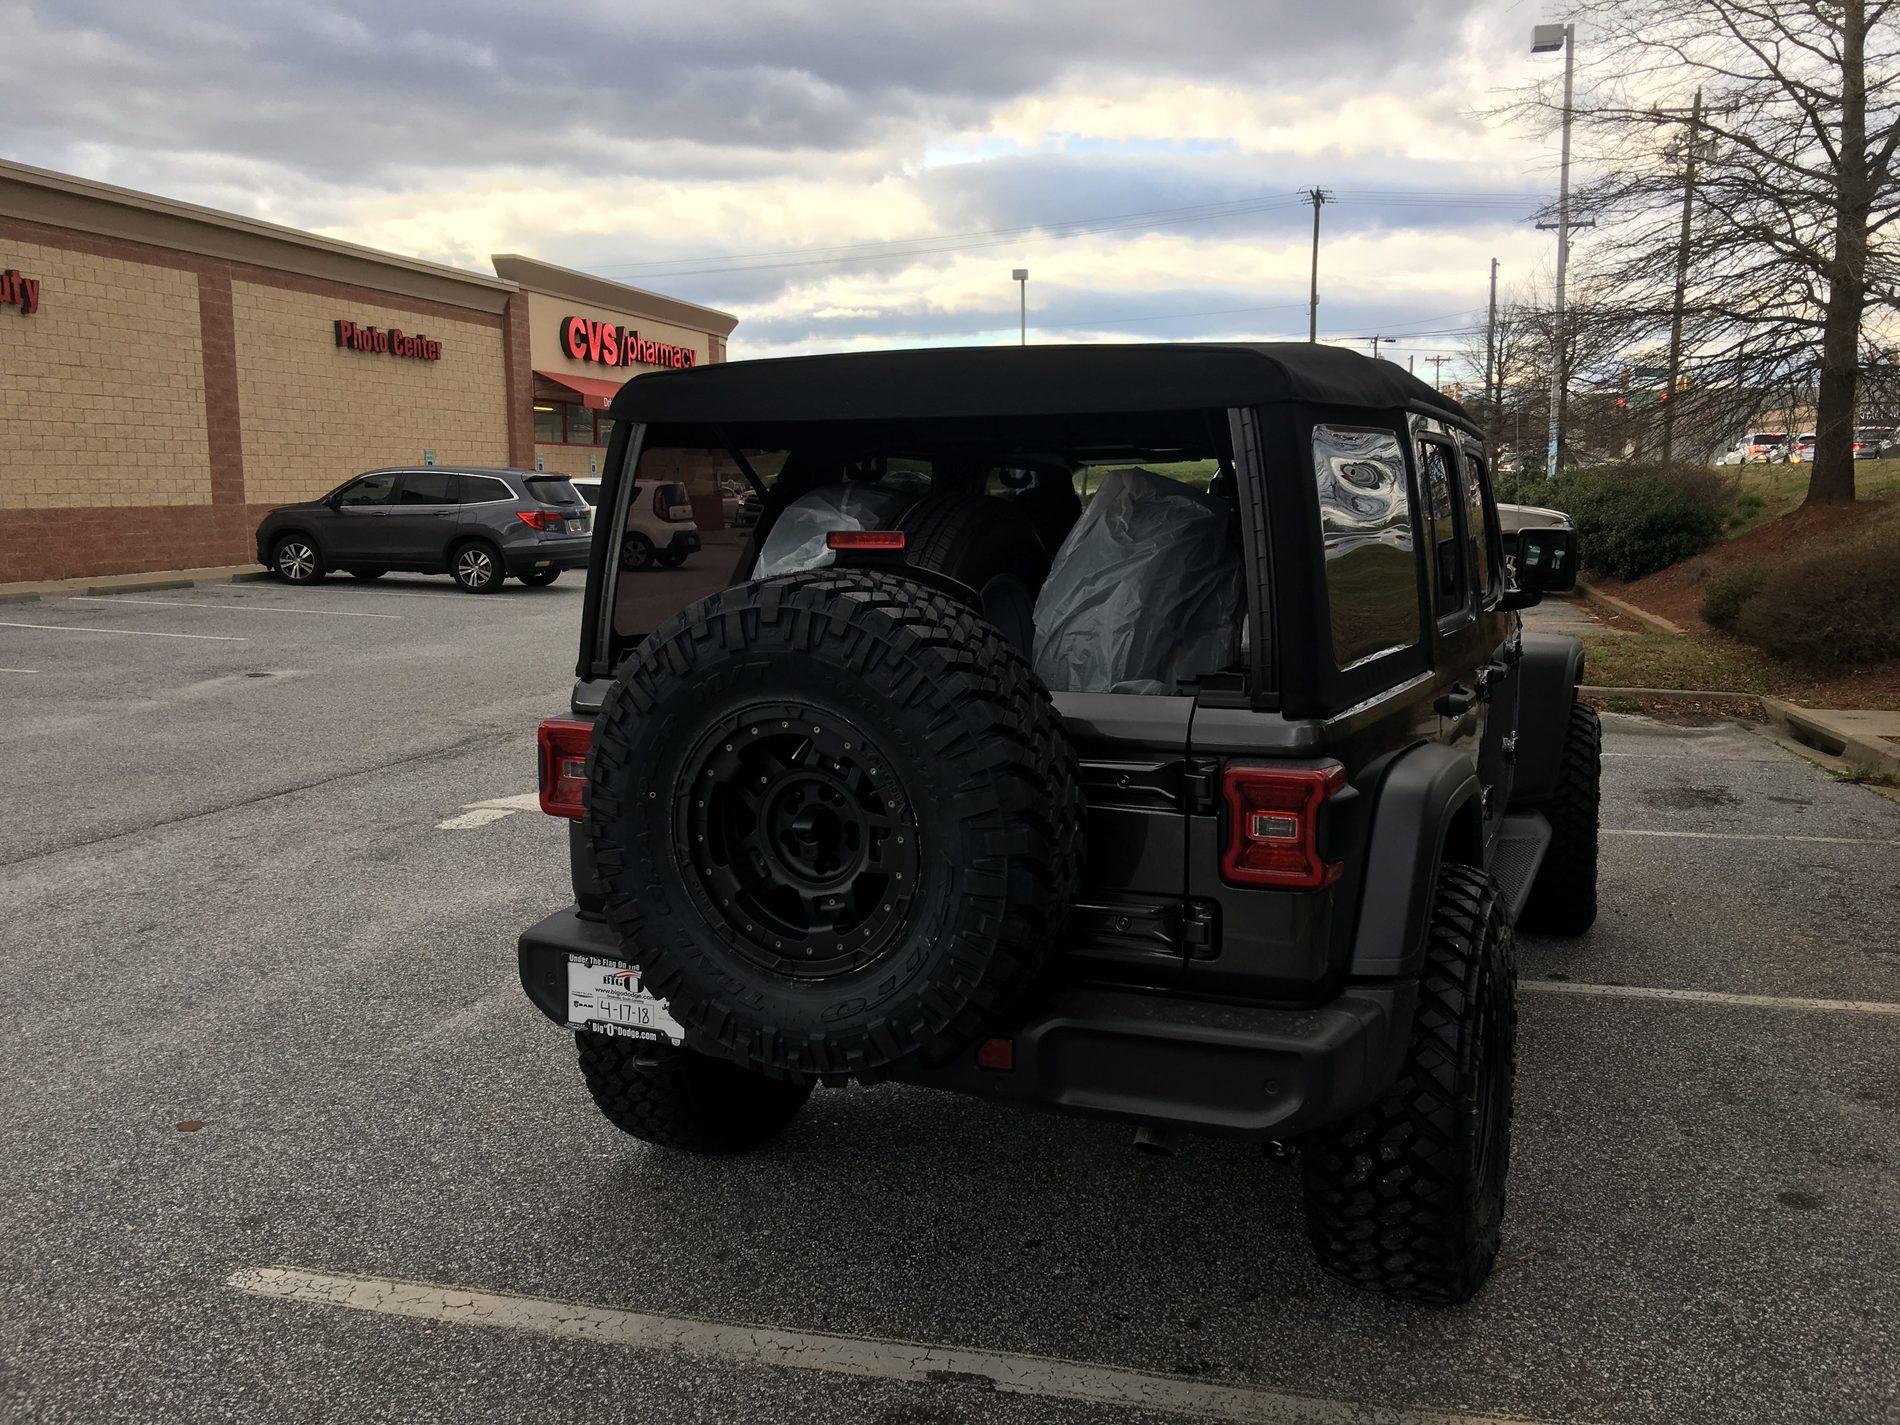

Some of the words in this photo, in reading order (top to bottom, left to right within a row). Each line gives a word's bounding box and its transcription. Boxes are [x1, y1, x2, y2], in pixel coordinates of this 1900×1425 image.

[335, 320, 389, 353] Photo
[388, 329, 442, 360] Center
[562, 316, 697, 368] CVS/pharmacy
[569, 954, 588, 963] Under
[590, 957, 601, 965] The
[603, 959, 617, 968] Flag
[618, 961, 627, 969] On
[600, 1000, 650, 1024] 4-17-18
